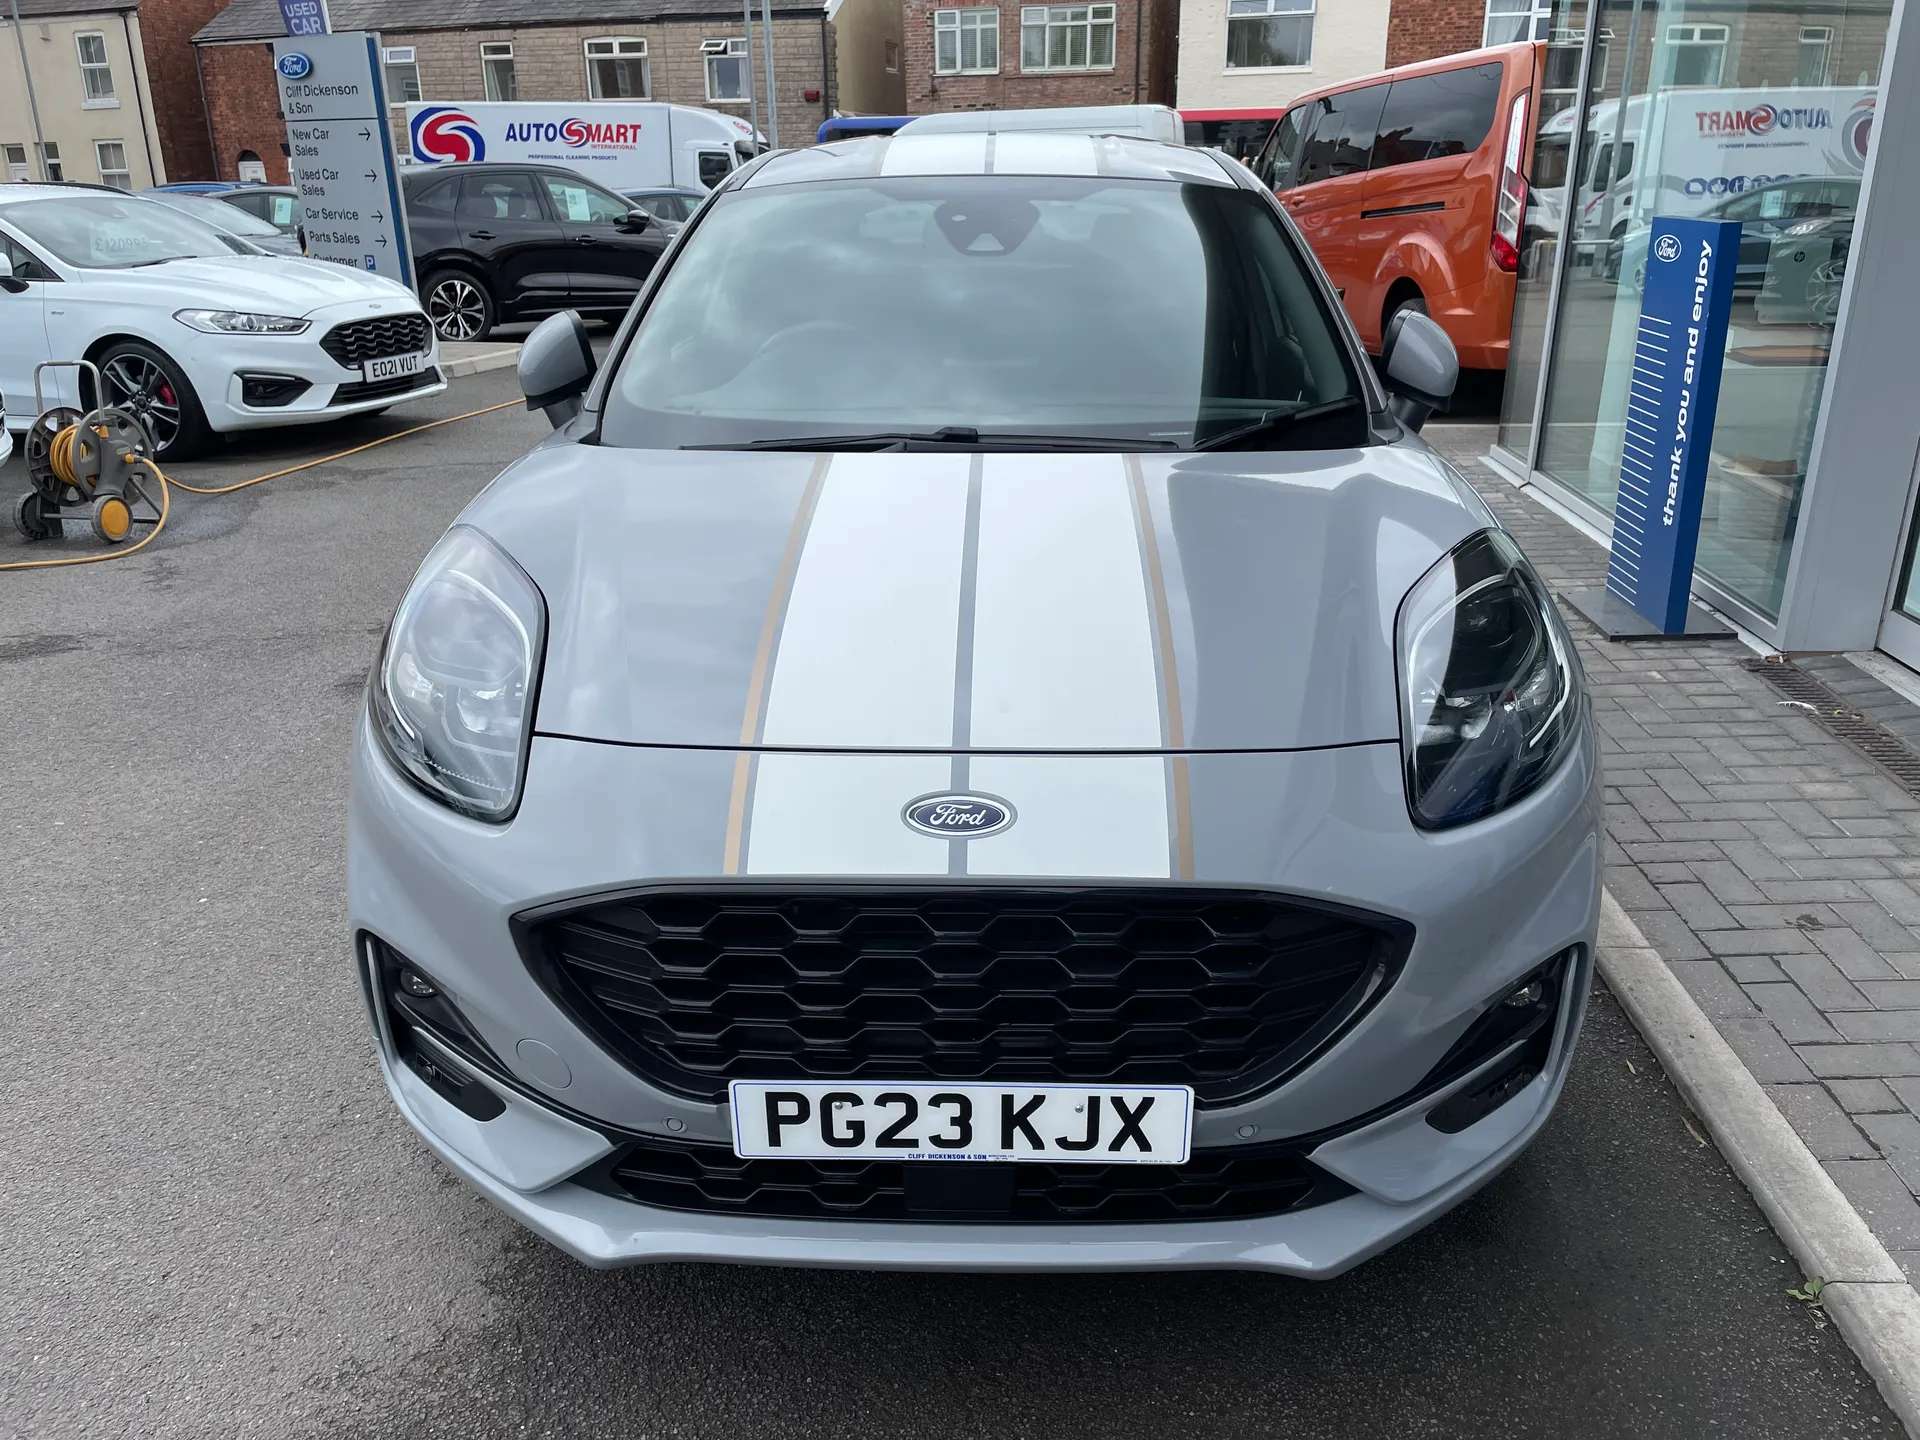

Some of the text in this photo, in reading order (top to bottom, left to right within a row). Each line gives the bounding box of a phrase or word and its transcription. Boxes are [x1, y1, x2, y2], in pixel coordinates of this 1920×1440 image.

[285, 1, 318, 17] USED
[290, 16, 323, 35] CAR
[283, 56, 303, 74] Ford
[286, 84, 359, 98] Cliff Dickenson
[288, 102, 314, 114] & Son
[292, 127, 330, 140] New Car
[505, 117, 642, 148] AUTOSMART
[295, 144, 319, 157] Sales
[298, 168, 339, 180] Used Car
[301, 184, 325, 197] Sales
[305, 207, 359, 220] Car Service
[309, 230, 360, 245] Parts Sales
[1658, 237, 1678, 258] Ford
[398, 354, 418, 373] VUT
[1663, 240, 1713, 526] thank you and enjoy
[929, 803, 987, 825] Ford
[764, 1091, 1155, 1152] PG23 KJX
